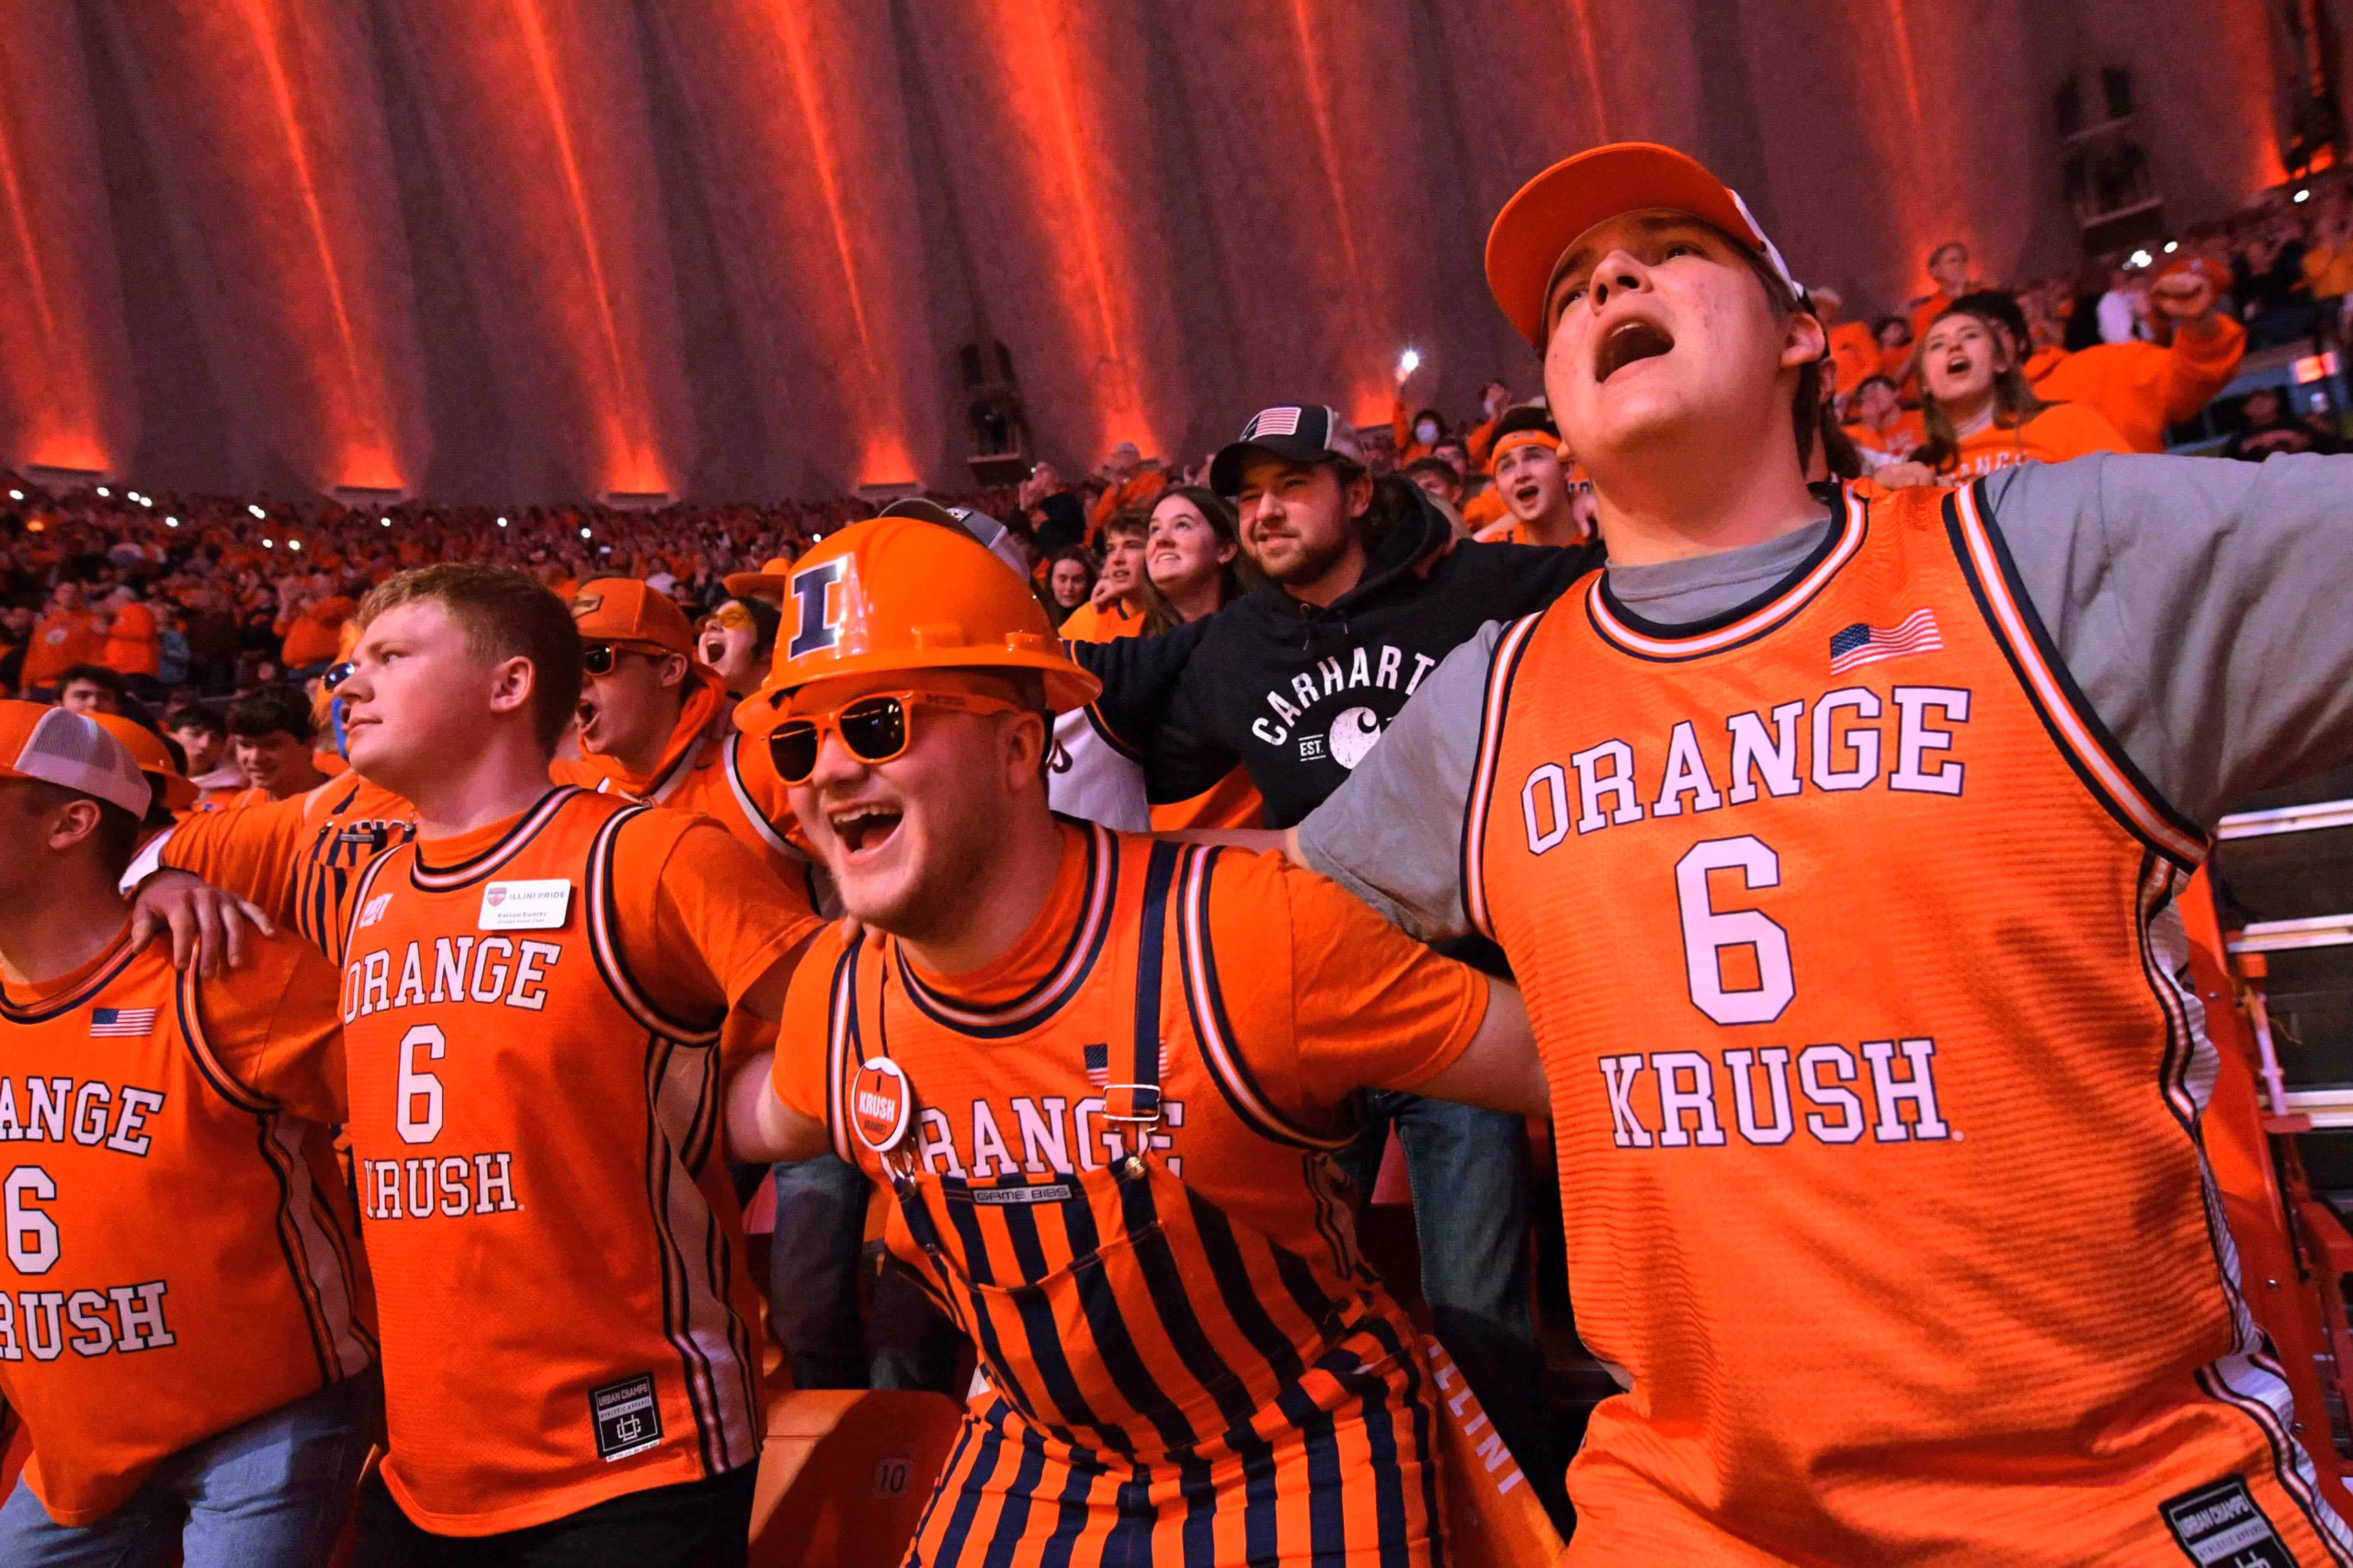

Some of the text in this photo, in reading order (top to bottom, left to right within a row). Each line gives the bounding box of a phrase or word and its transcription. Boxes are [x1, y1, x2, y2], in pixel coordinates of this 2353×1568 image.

[788, 553, 849, 662] I
[1252, 645, 1436, 745] CARHART
[1300, 740, 1324, 756] EST.
[1521, 686, 1971, 856] ORANGE
[509, 891, 565, 901] ILLINI PRIDE
[1675, 835, 1796, 1027] 6
[344, 936, 563, 1026] ORANGE
[0, 1075, 165, 1157] ANGE
[396, 1023, 446, 1145] 6
[858, 1090, 896, 1122] KRUSH
[1598, 1037, 1950, 1148] KRUSH
[880, 1097, 1185, 1182] RANGE
[4, 1165, 61, 1275] 6
[976, 1187, 1068, 1201] GAME BIBS
[0, 1279, 176, 1361] RUSH
[598, 1382, 648, 1407] URBAN CHAMPS
[881, 1464, 906, 1494] 10
